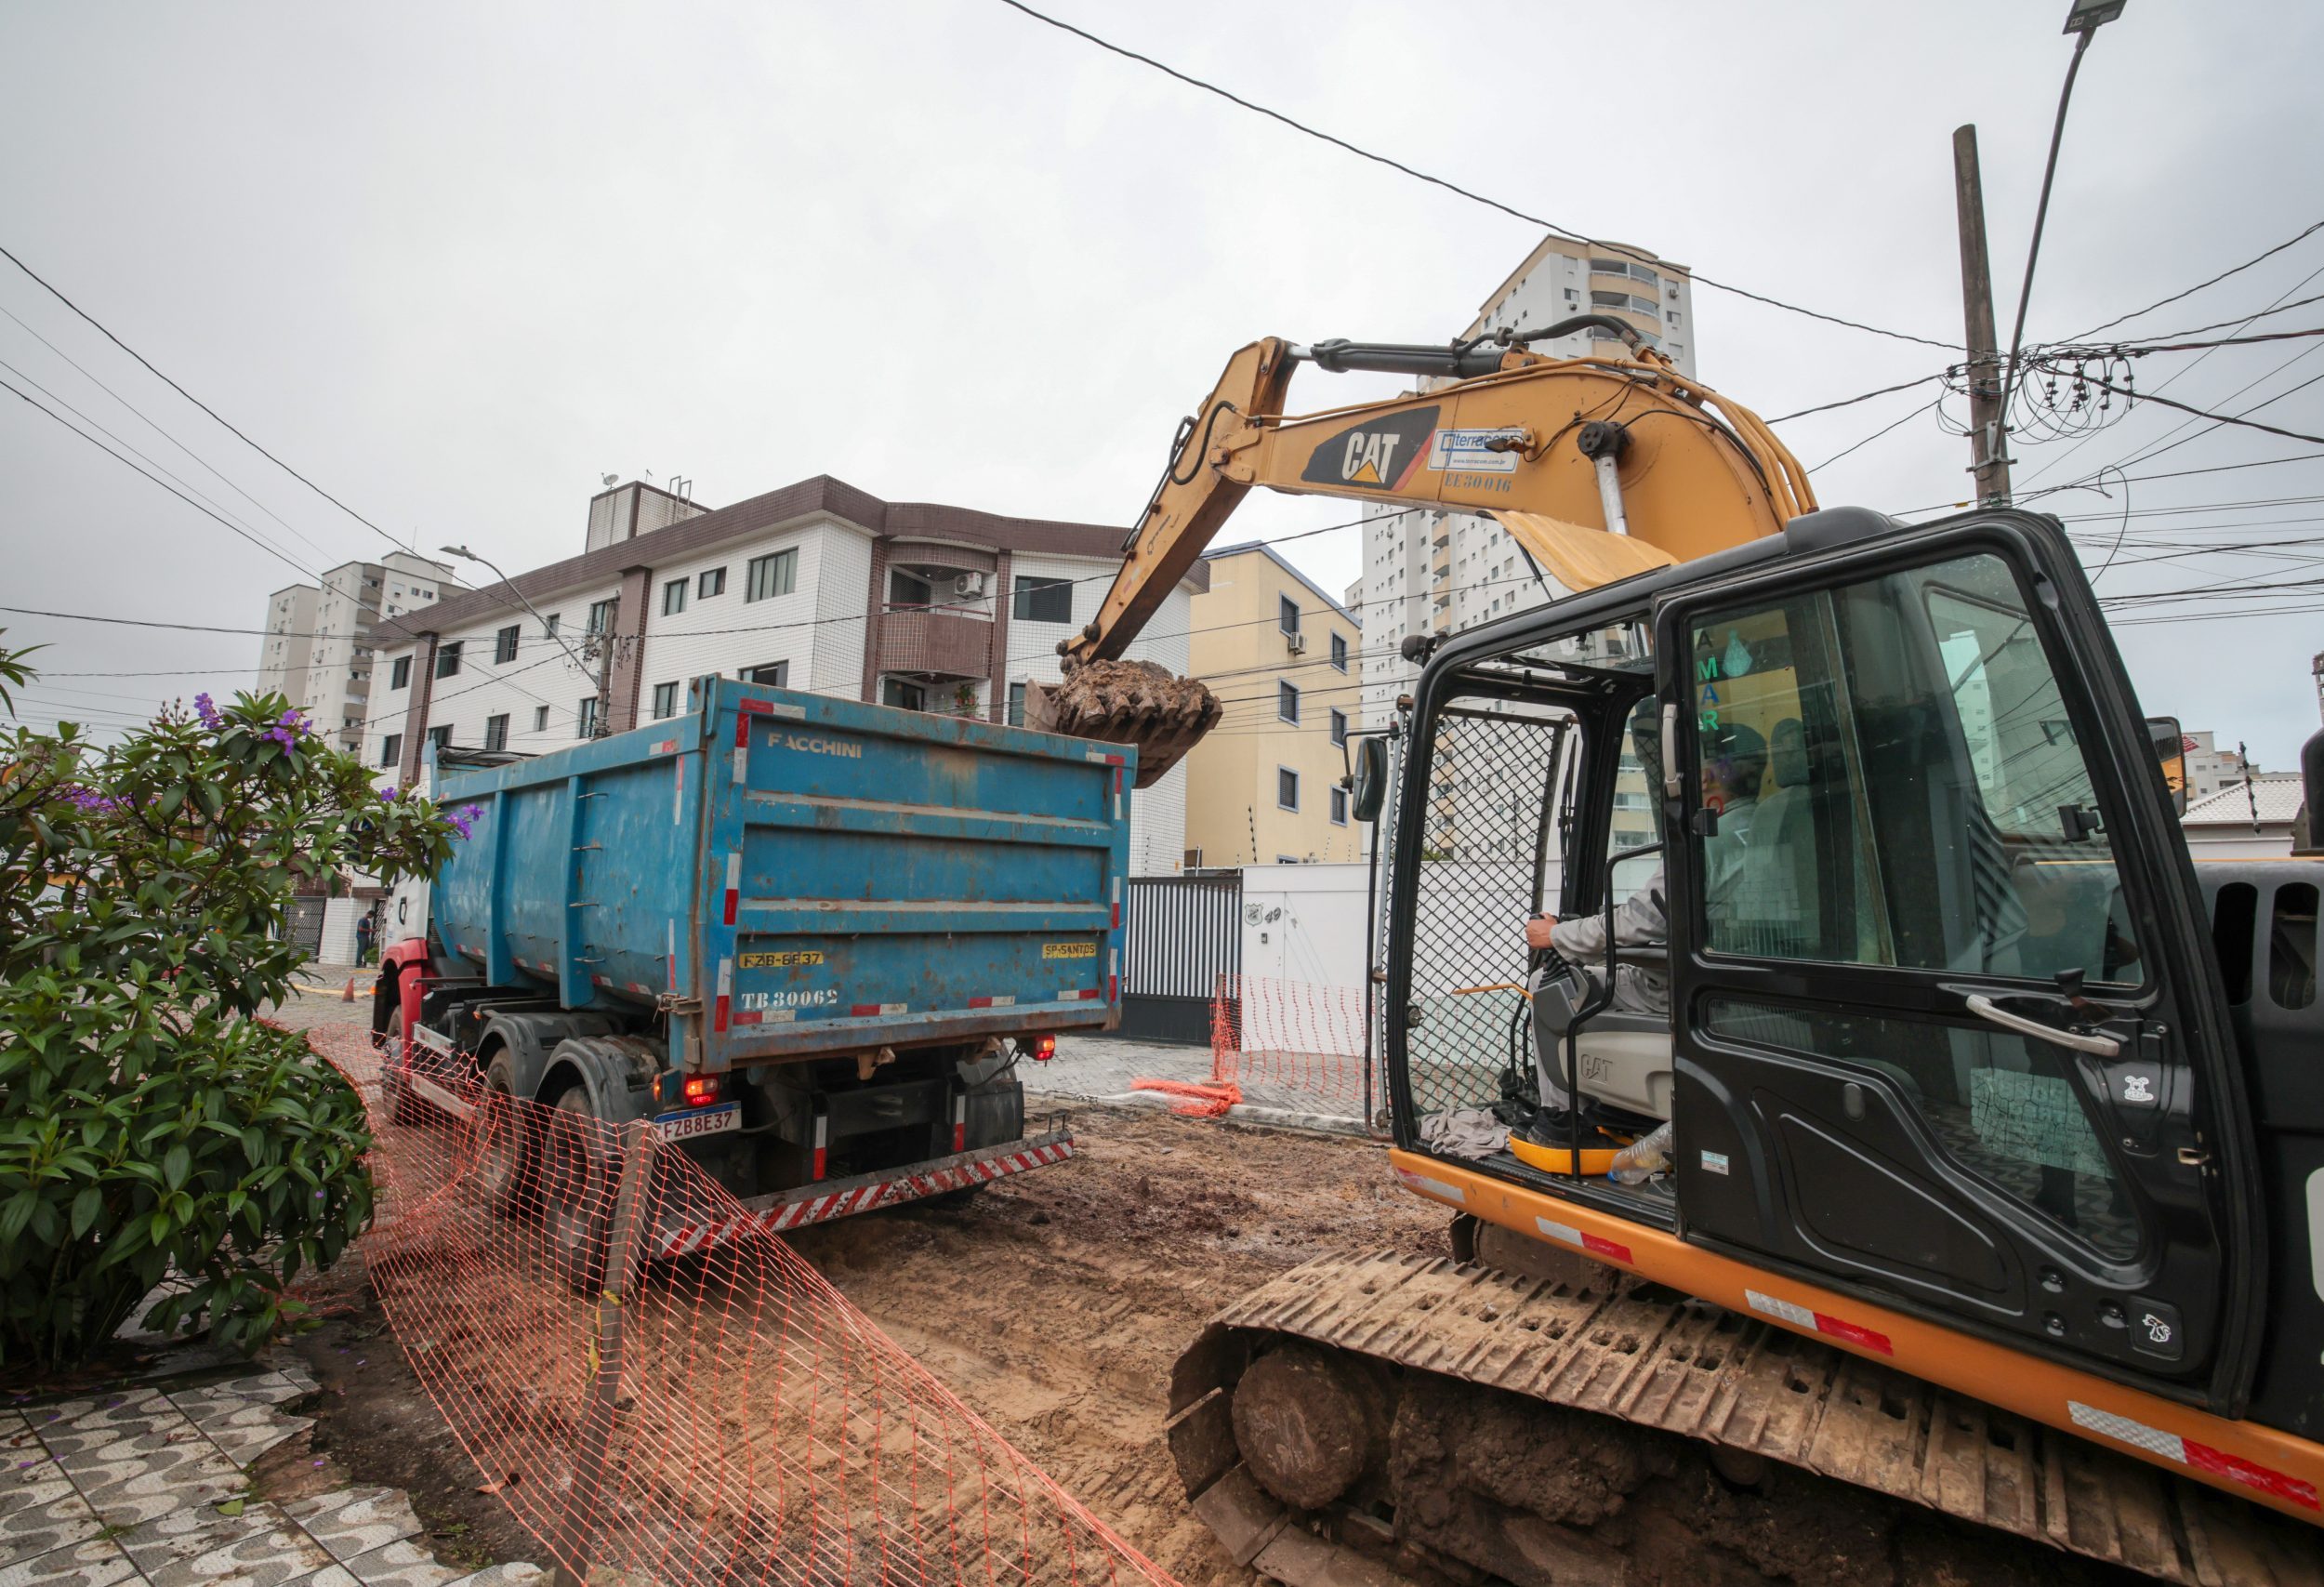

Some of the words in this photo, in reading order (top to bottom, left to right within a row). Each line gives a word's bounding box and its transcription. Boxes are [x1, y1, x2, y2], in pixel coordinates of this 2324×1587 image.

[1341, 431, 1400, 483] CAT
[768, 733, 863, 760] FACCHINI
[1264, 906, 1282, 923] 49
[1580, 1053, 1614, 1083] CAT
[664, 1111, 733, 1139] FZB8E37
